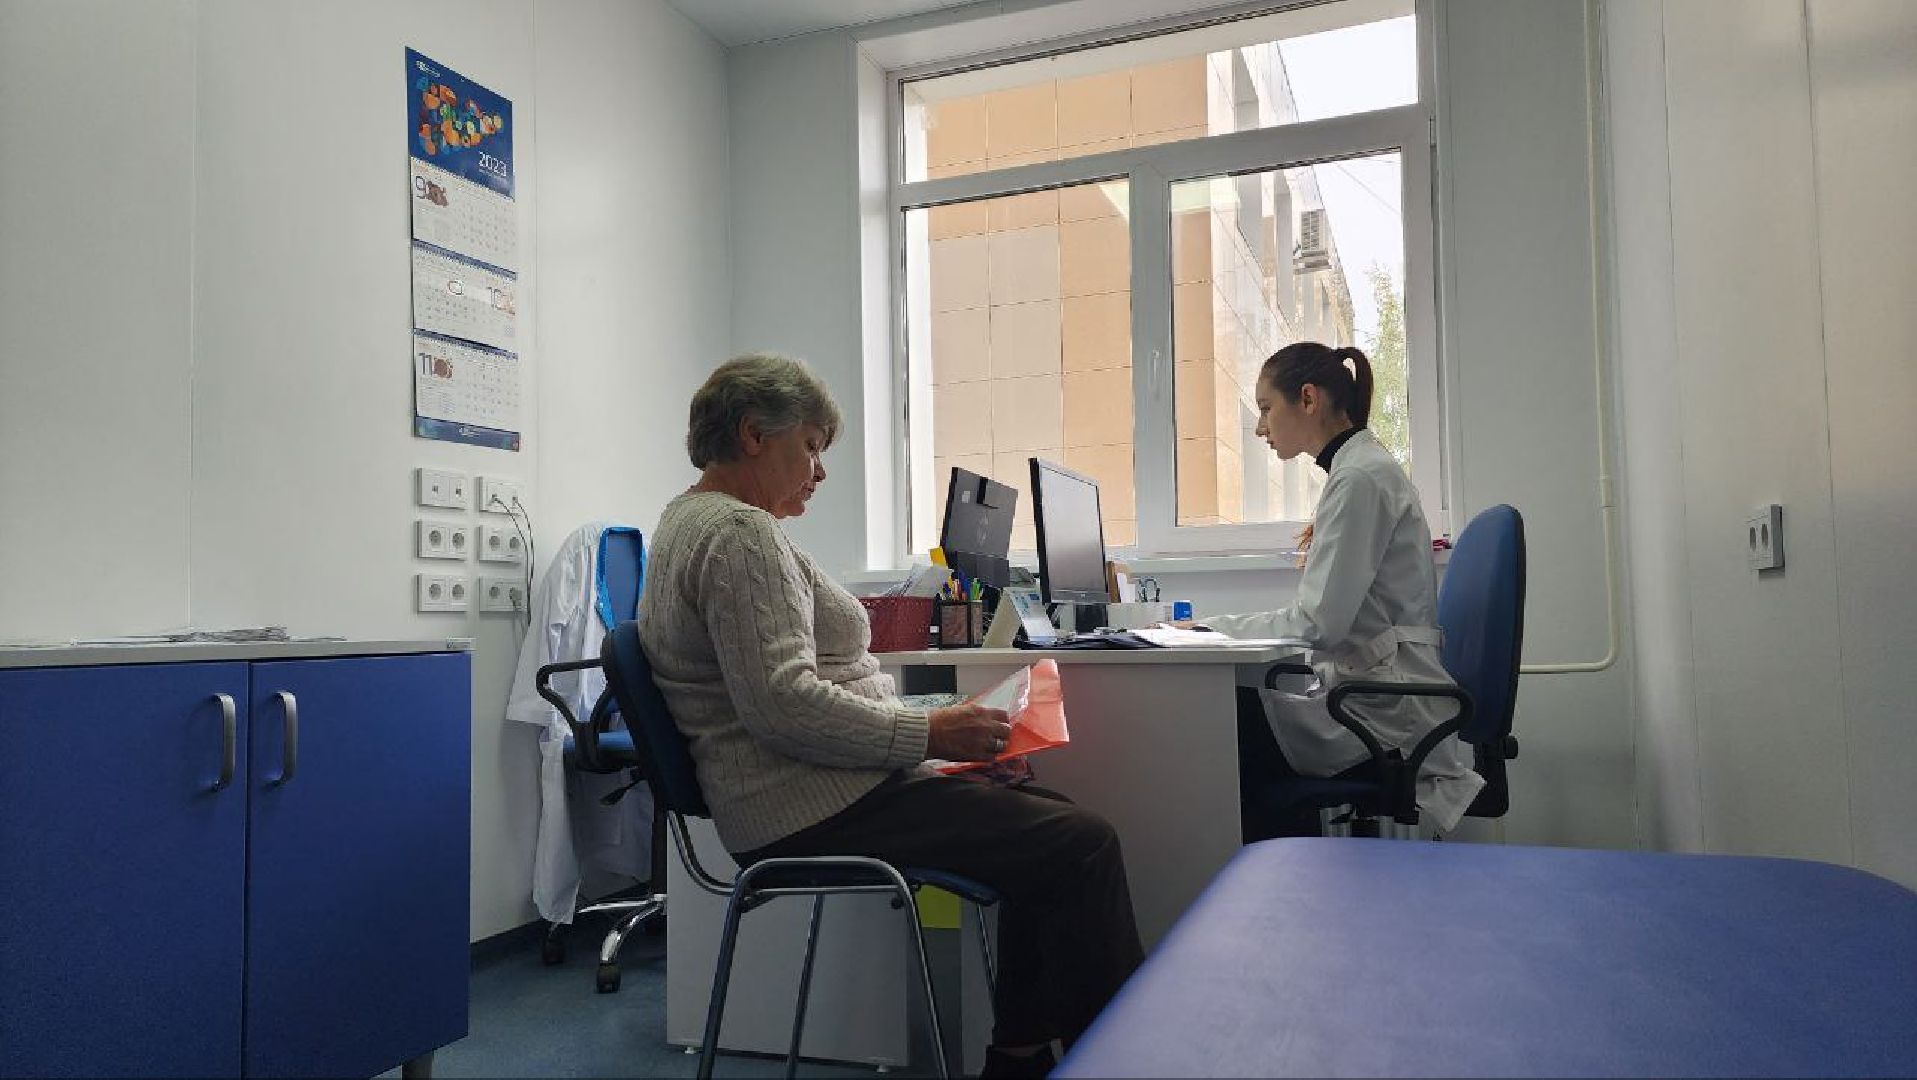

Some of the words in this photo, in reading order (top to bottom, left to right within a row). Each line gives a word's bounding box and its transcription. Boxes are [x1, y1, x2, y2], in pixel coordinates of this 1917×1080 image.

[478, 151, 507, 177] 2023
[415, 175, 427, 200] 9
[418, 352, 432, 376] 11
